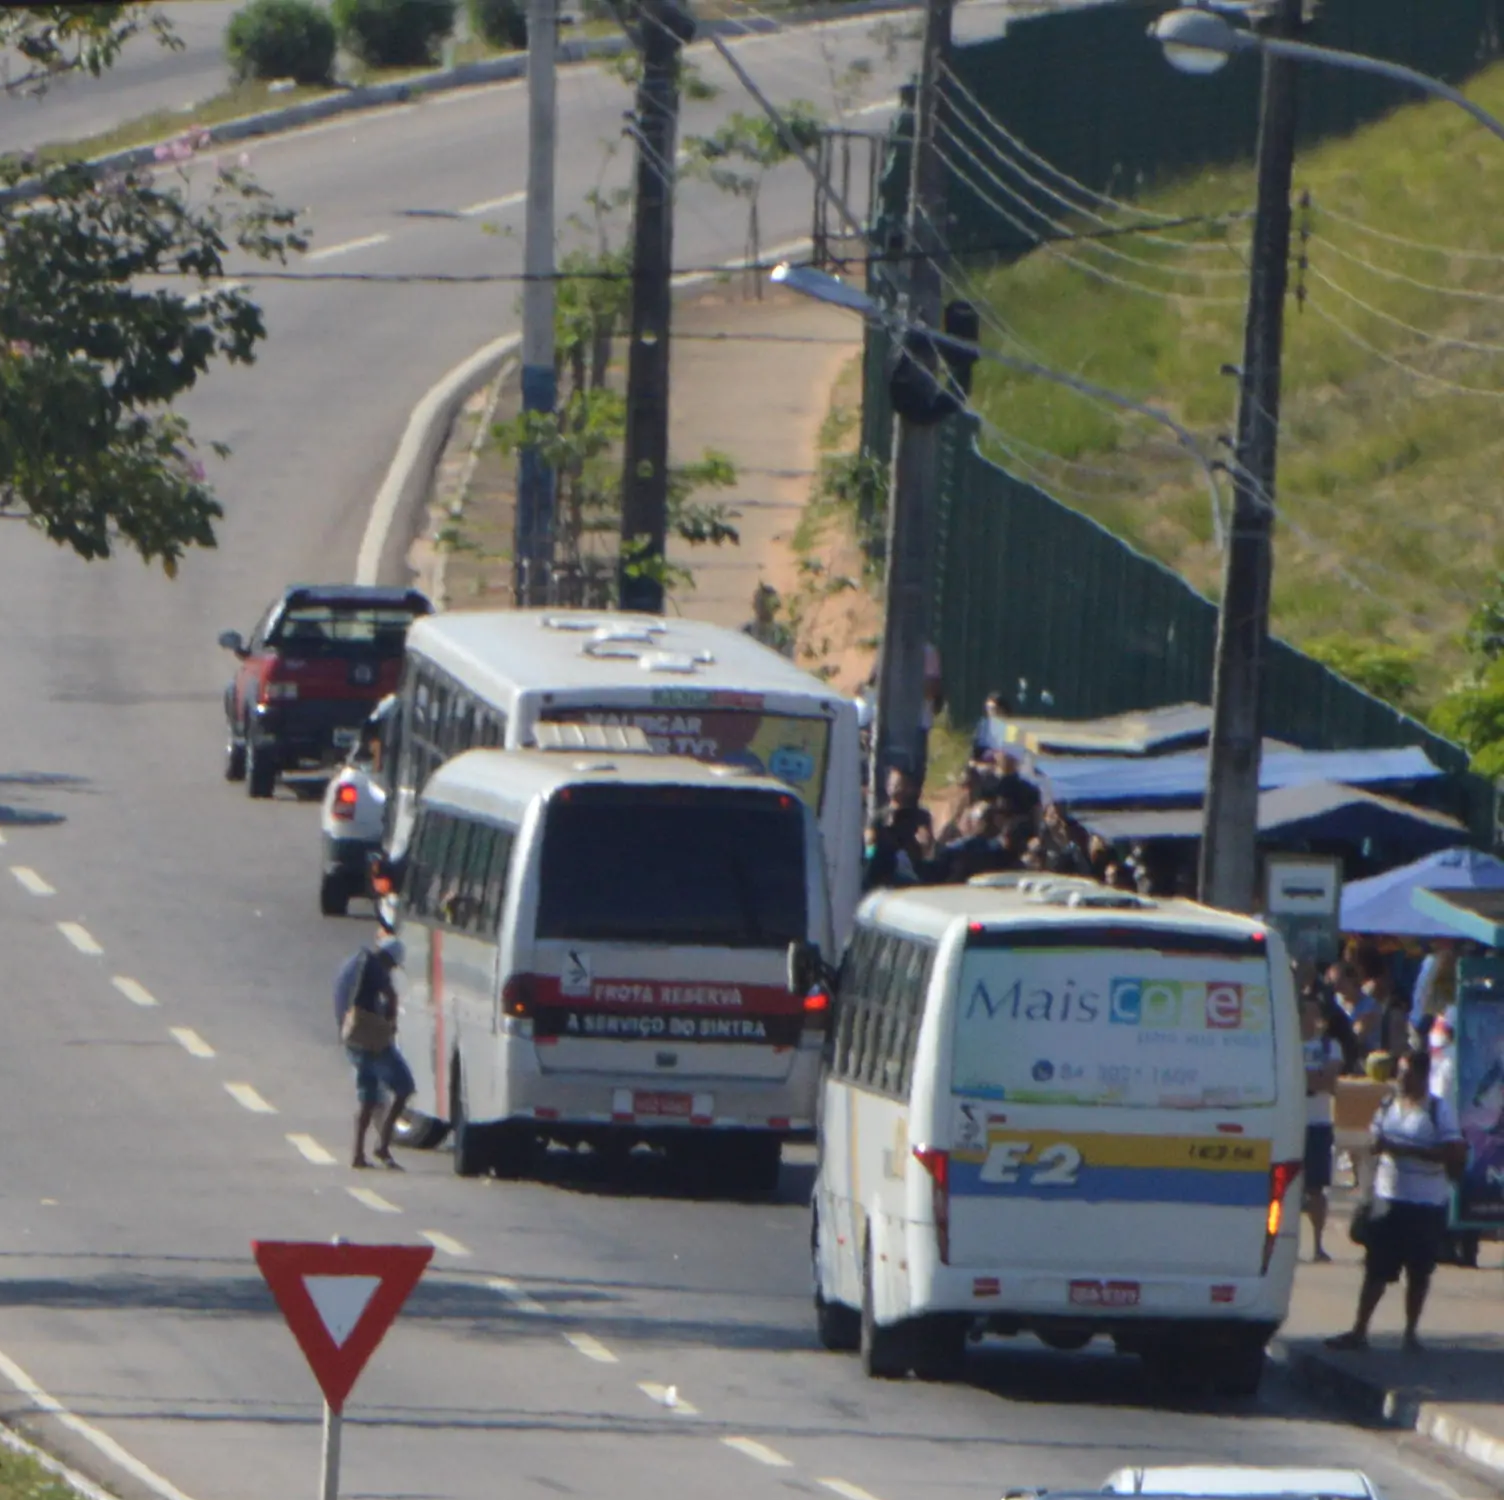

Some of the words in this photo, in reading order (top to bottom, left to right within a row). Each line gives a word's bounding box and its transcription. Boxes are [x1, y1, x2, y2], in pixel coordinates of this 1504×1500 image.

[594, 983, 654, 1003] FROTA
[660, 986, 743, 1006] RESERVA
[964, 977, 1101, 1023] Mais
[1110, 979, 1268, 1026] cores
[583, 1013, 665, 1037] SERVIÇO
